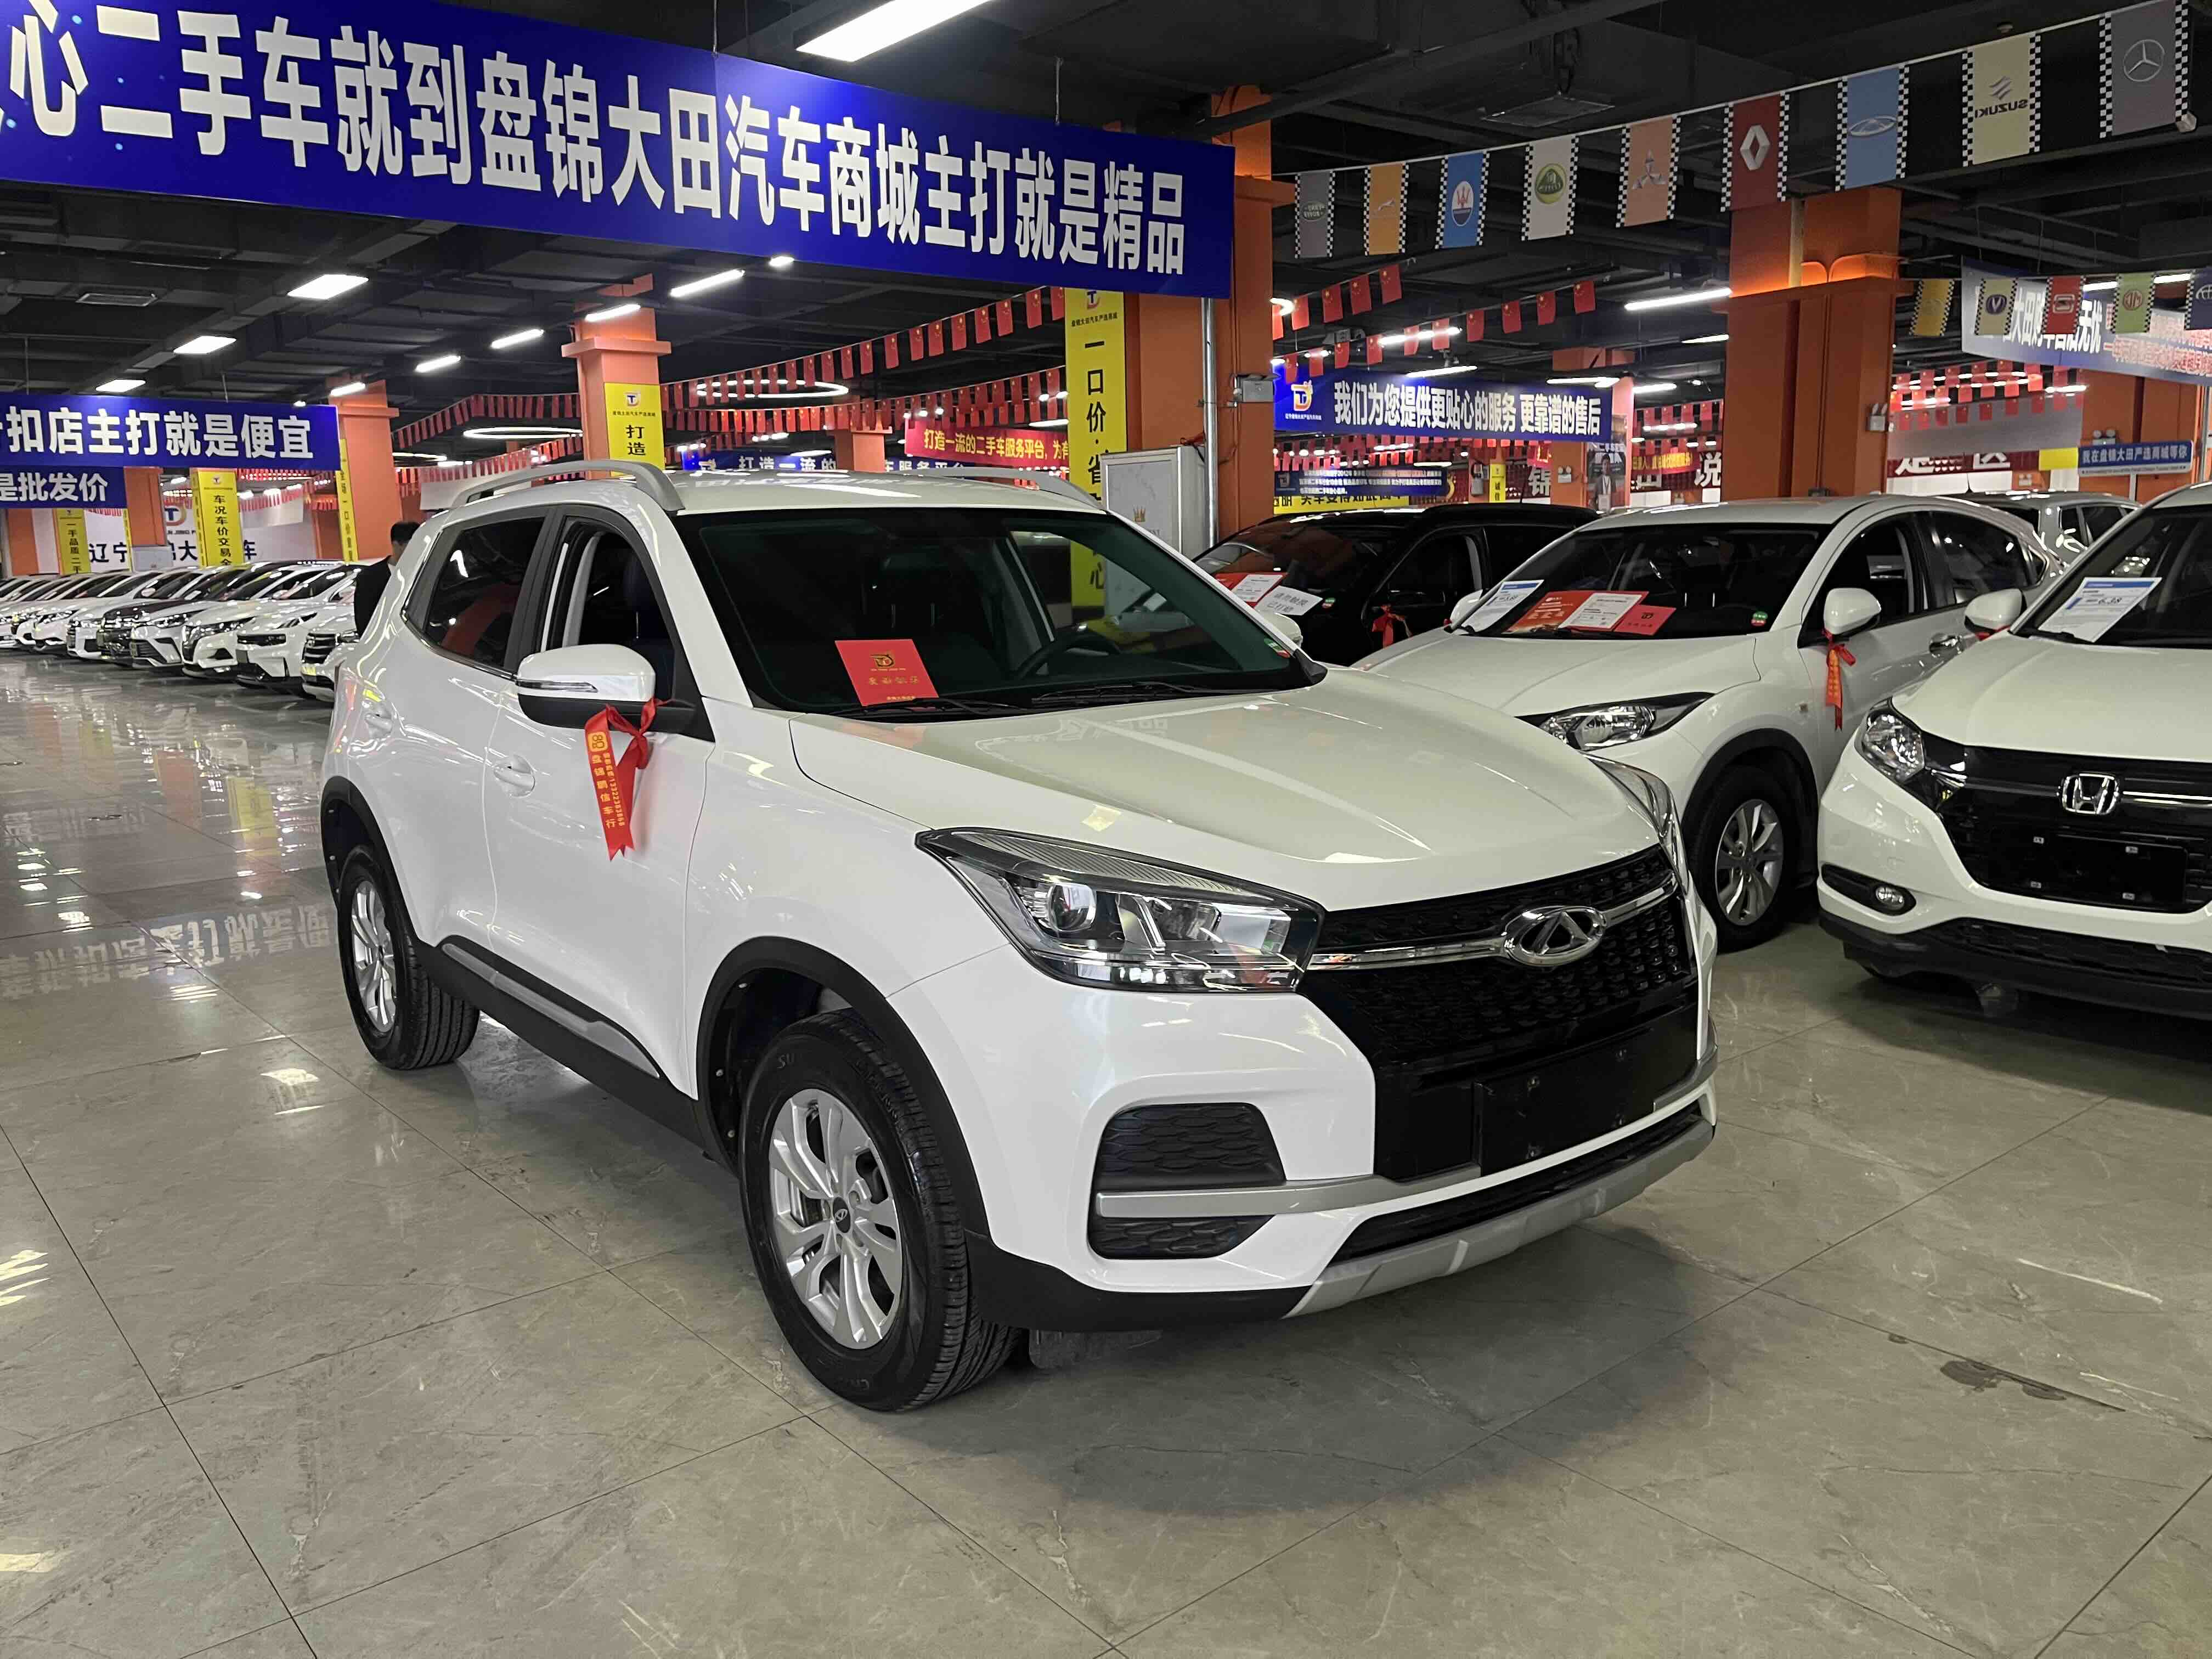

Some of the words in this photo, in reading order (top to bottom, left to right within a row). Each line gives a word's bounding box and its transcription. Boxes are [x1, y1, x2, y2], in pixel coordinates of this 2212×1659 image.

[0, 0, 1184, 275] 心二手车就到盘锦大田汽车商城主打就是精品
[0, 406, 314, 459] 扣店主打就是便宜
[1334, 380, 1516, 432] 我们为您提供更贴心的服务
[1520, 393, 1601, 436] 更靠谱的售后
[626, 424, 646, 456] 打造
[0, 472, 108, 502] 是批发价
